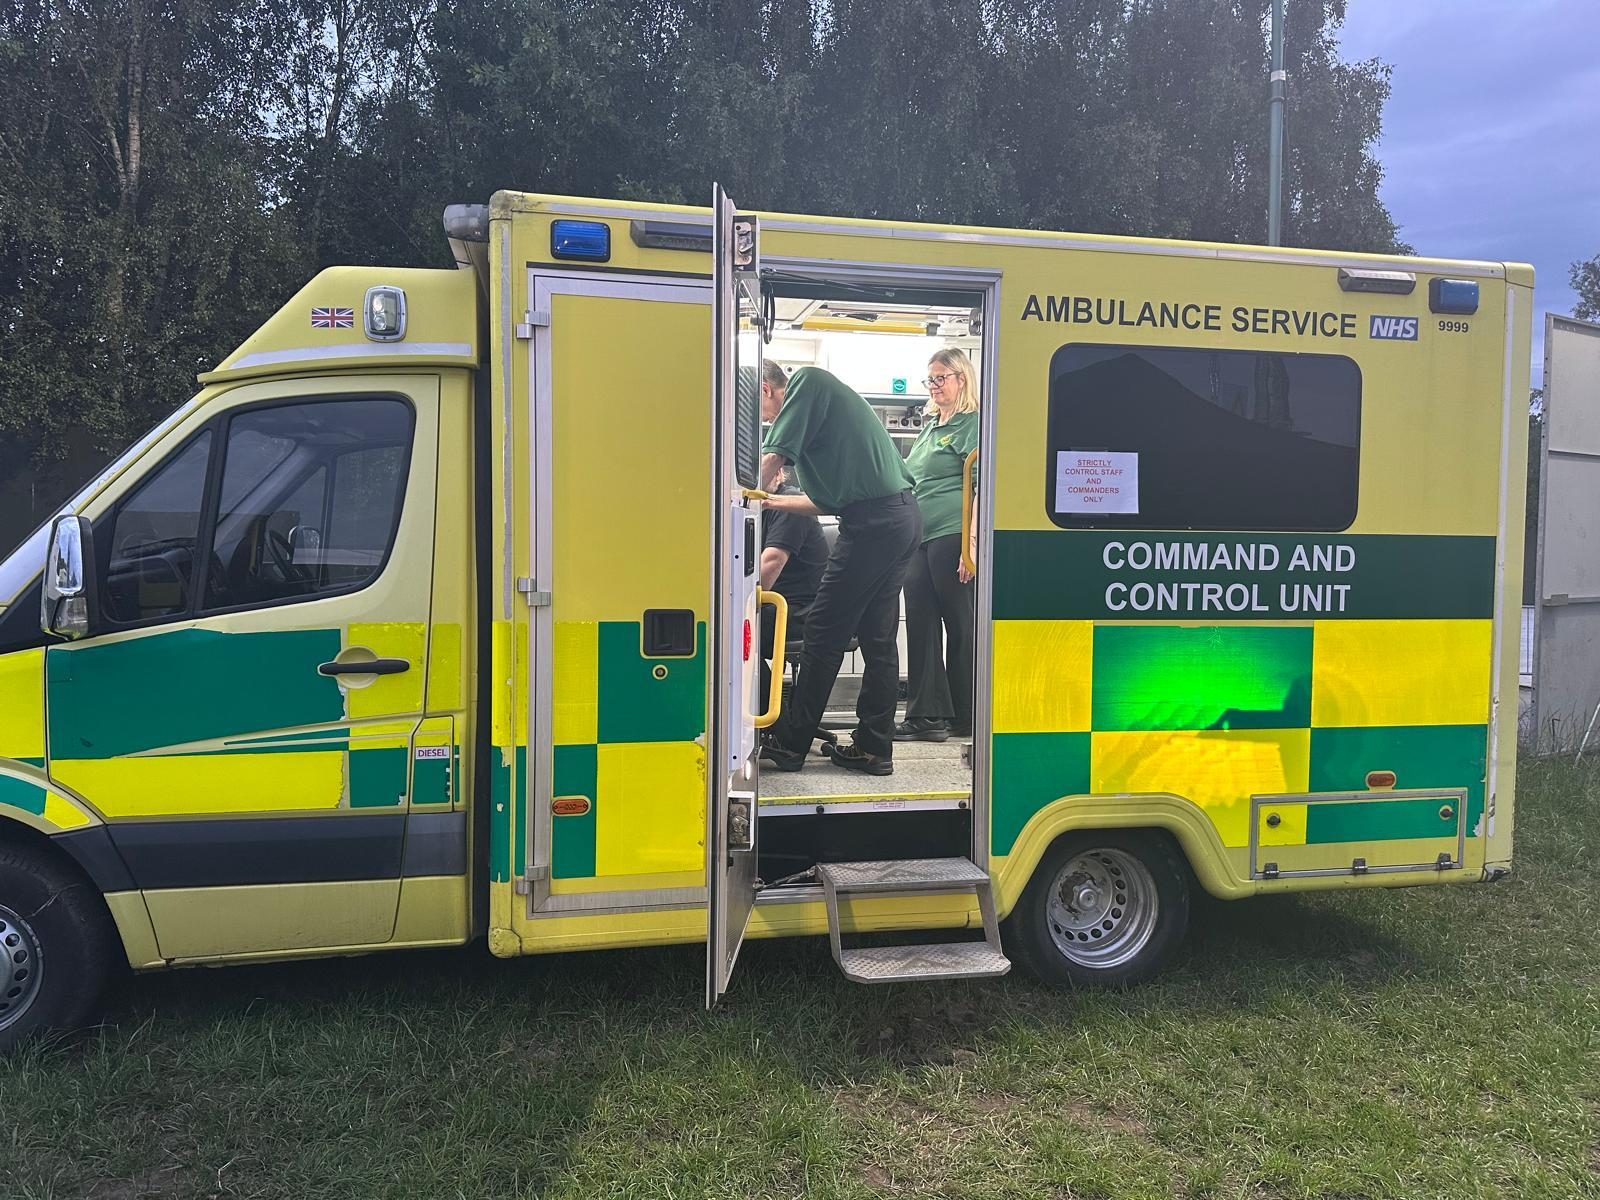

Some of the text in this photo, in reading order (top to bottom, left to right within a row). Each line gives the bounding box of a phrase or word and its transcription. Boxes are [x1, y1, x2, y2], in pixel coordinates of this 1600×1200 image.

[1020, 293, 1357, 338] AMBULANCE SERVICE
[1437, 319, 1470, 334] 9999
[1370, 316, 1416, 339] NHS
[1077, 459, 1112, 467] STRICTLY
[1102, 541, 1356, 572] COMMAND AND
[1104, 582, 1351, 612] CONTROL UNIT
[418, 749, 447, 757] DIESEL
